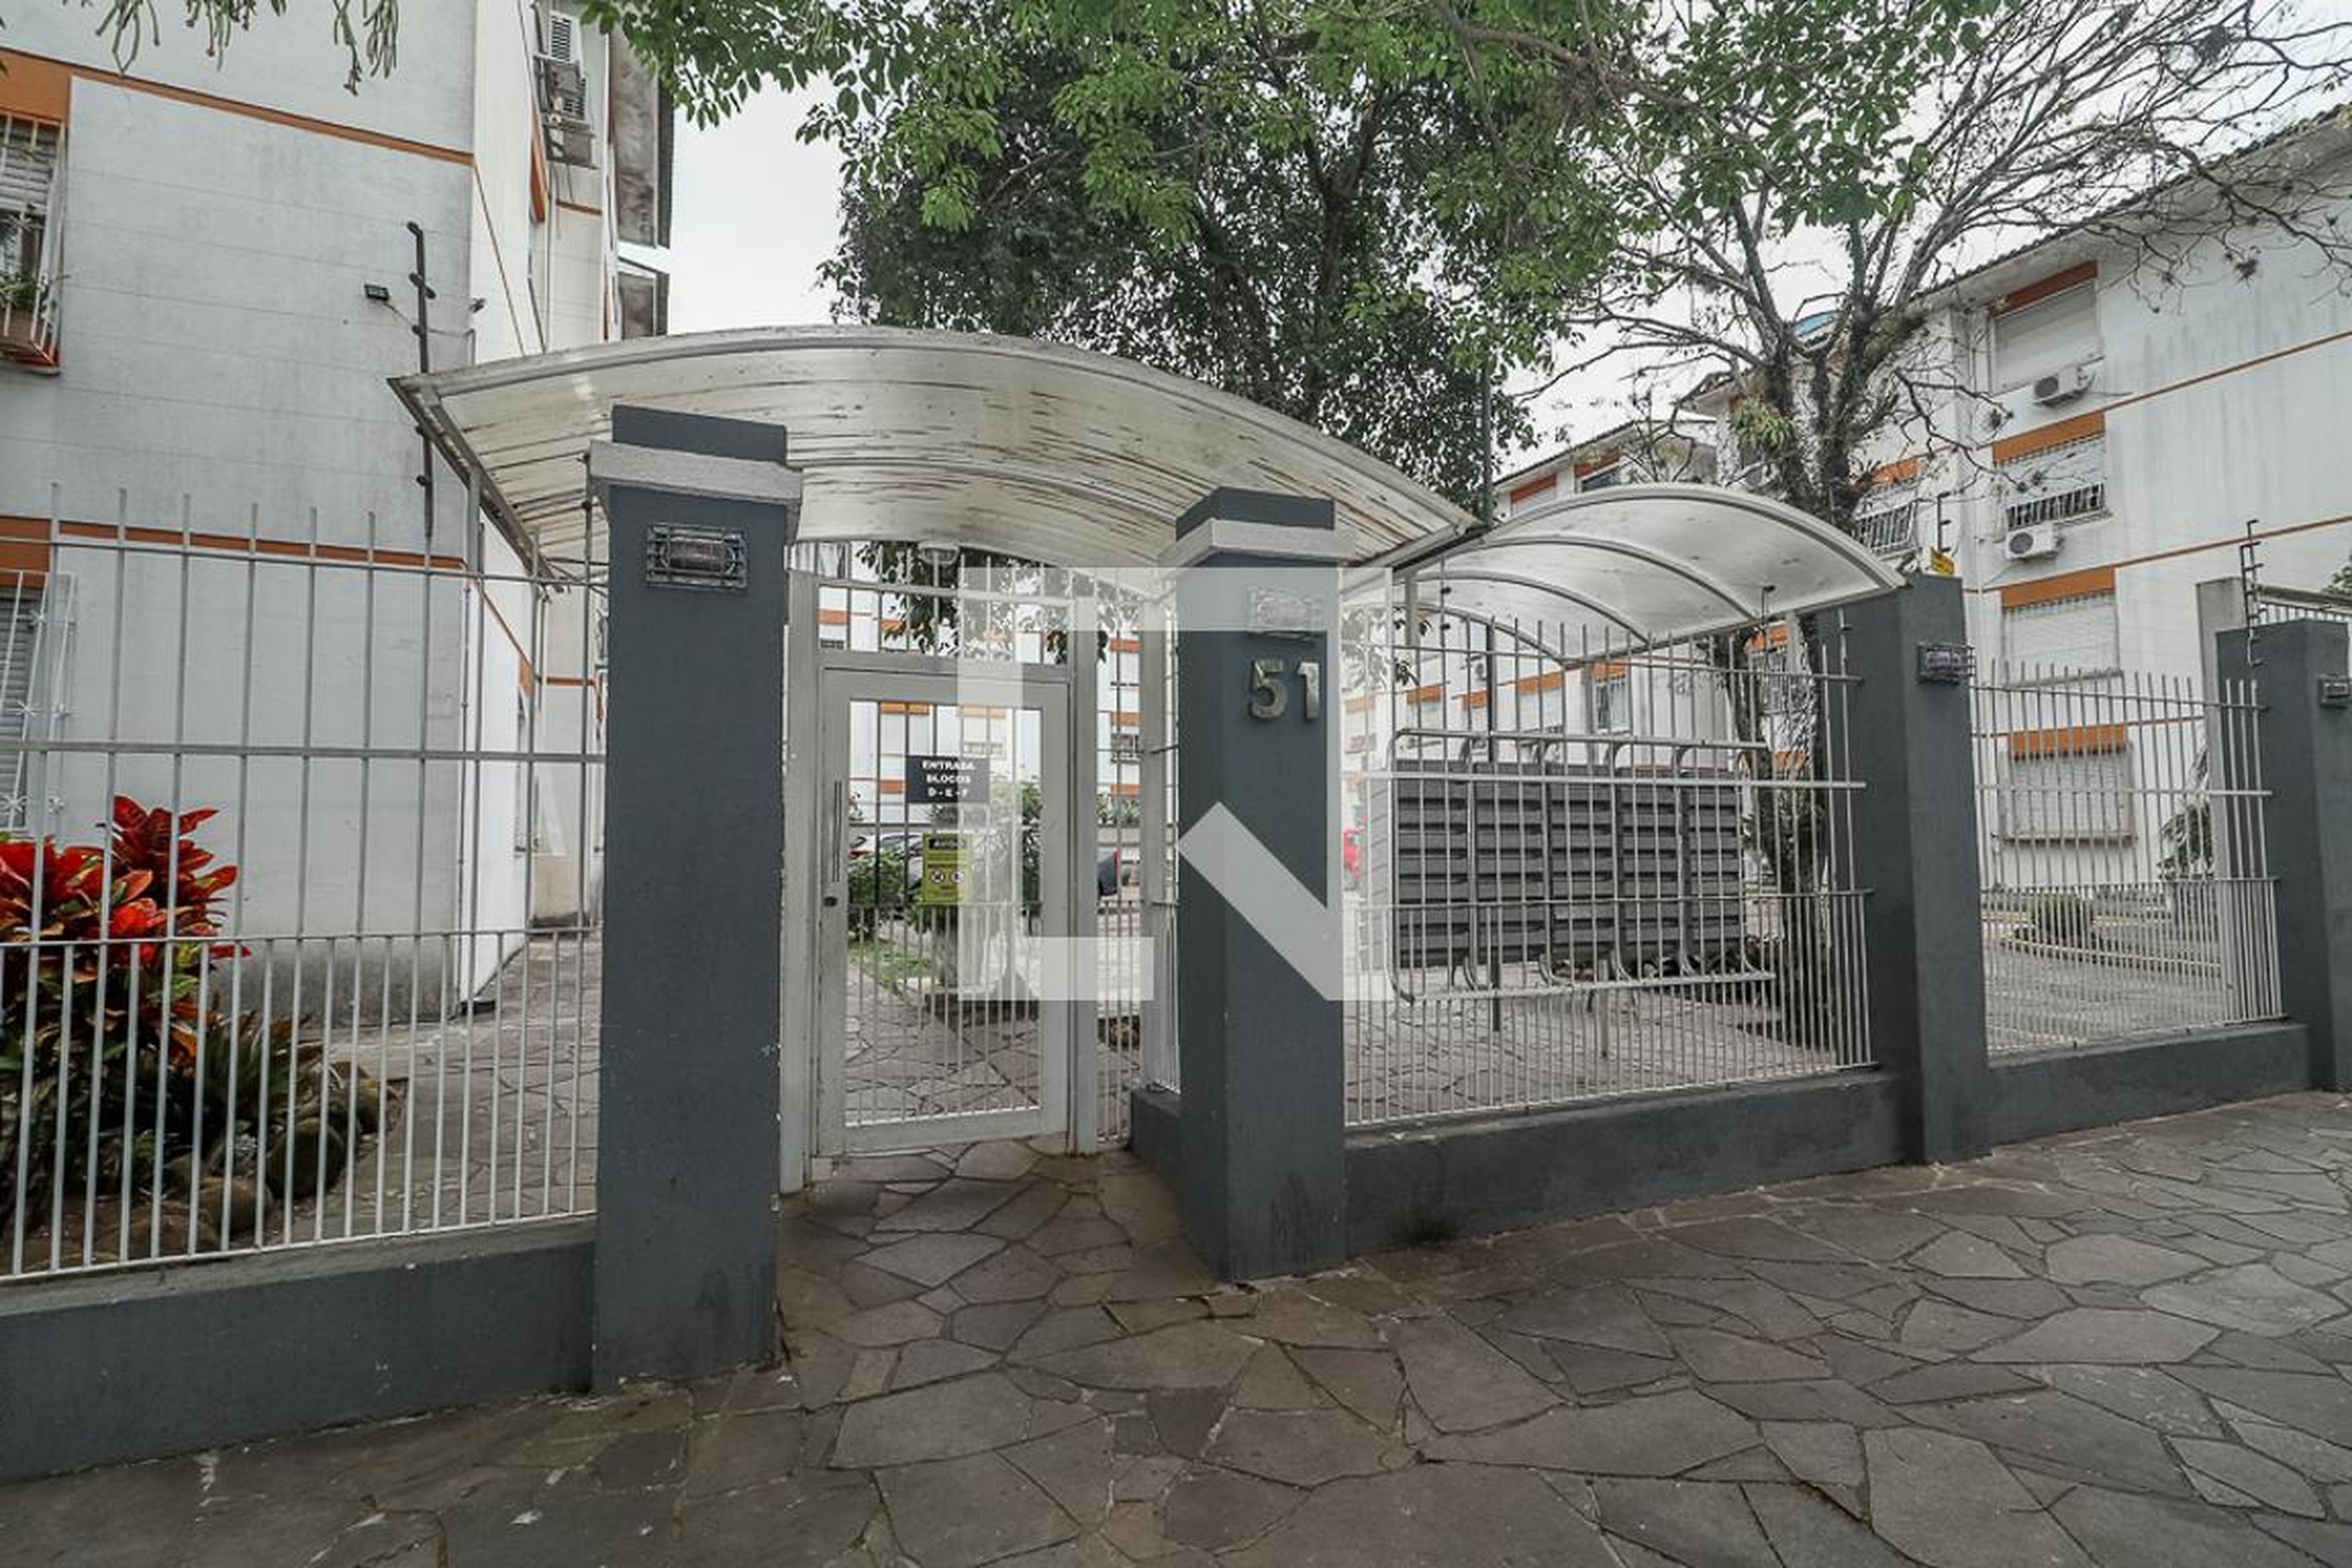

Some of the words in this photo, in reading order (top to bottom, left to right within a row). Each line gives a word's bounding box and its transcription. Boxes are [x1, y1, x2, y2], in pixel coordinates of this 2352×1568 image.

[1250, 658, 1320, 720] 51
[922, 760, 975, 770] ENTRADA
[927, 774, 970, 783] BLOCOS
